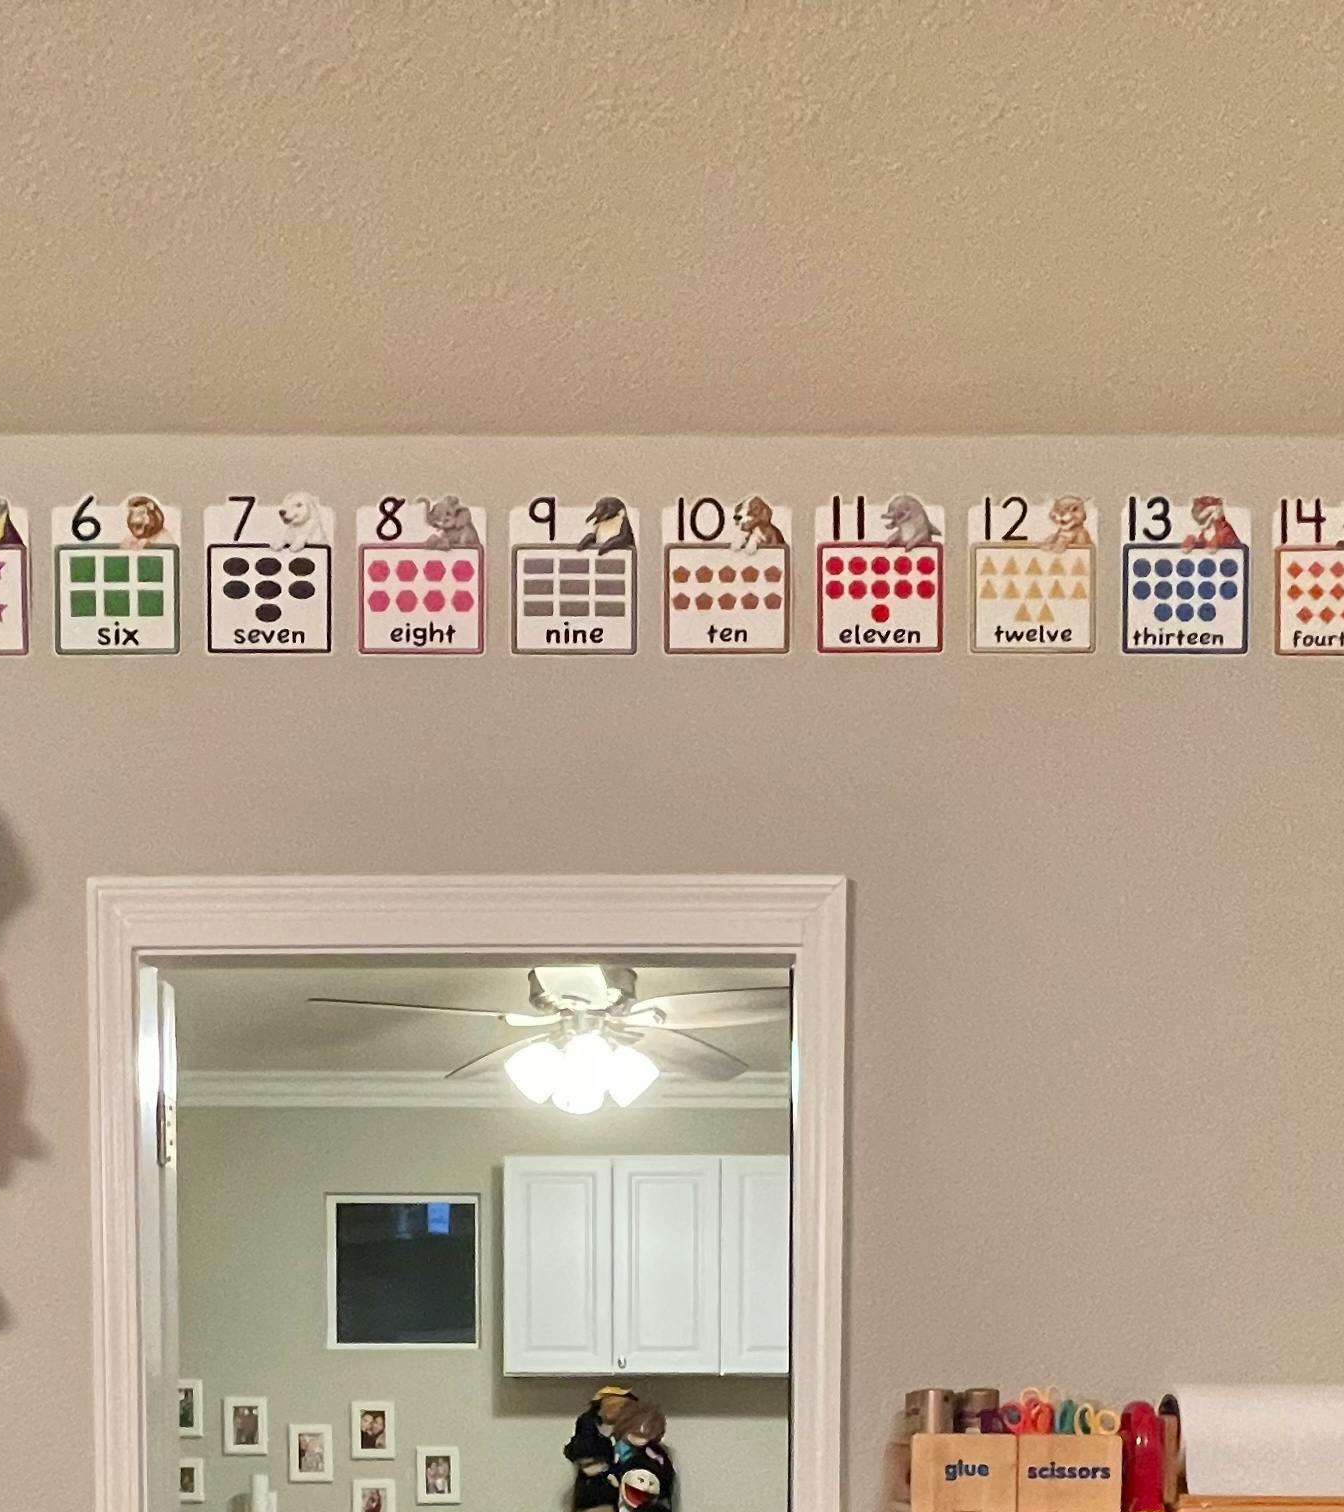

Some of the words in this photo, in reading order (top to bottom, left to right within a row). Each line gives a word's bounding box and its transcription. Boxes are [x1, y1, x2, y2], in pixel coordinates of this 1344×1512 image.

[71, 496, 102, 540] 6
[228, 496, 256, 541] 7
[376, 496, 404, 540] 8
[528, 496, 557, 541] 9
[676, 496, 724, 540] 10
[830, 495, 865, 539] 11
[984, 496, 1029, 540] 12
[1128, 496, 1172, 541] 13
[1280, 498, 1326, 542] 14
[97, 622, 140, 645] six
[233, 626, 306, 645] seven
[389, 622, 457, 648] eight
[545, 624, 604, 645] nine
[706, 624, 748, 644] ten
[838, 624, 921, 646] eleven
[994, 624, 1073, 645] twelve
[1132, 626, 1225, 648] thirteen
[944, 1459, 989, 1481] glue
[1028, 1461, 1111, 1479] scissors
